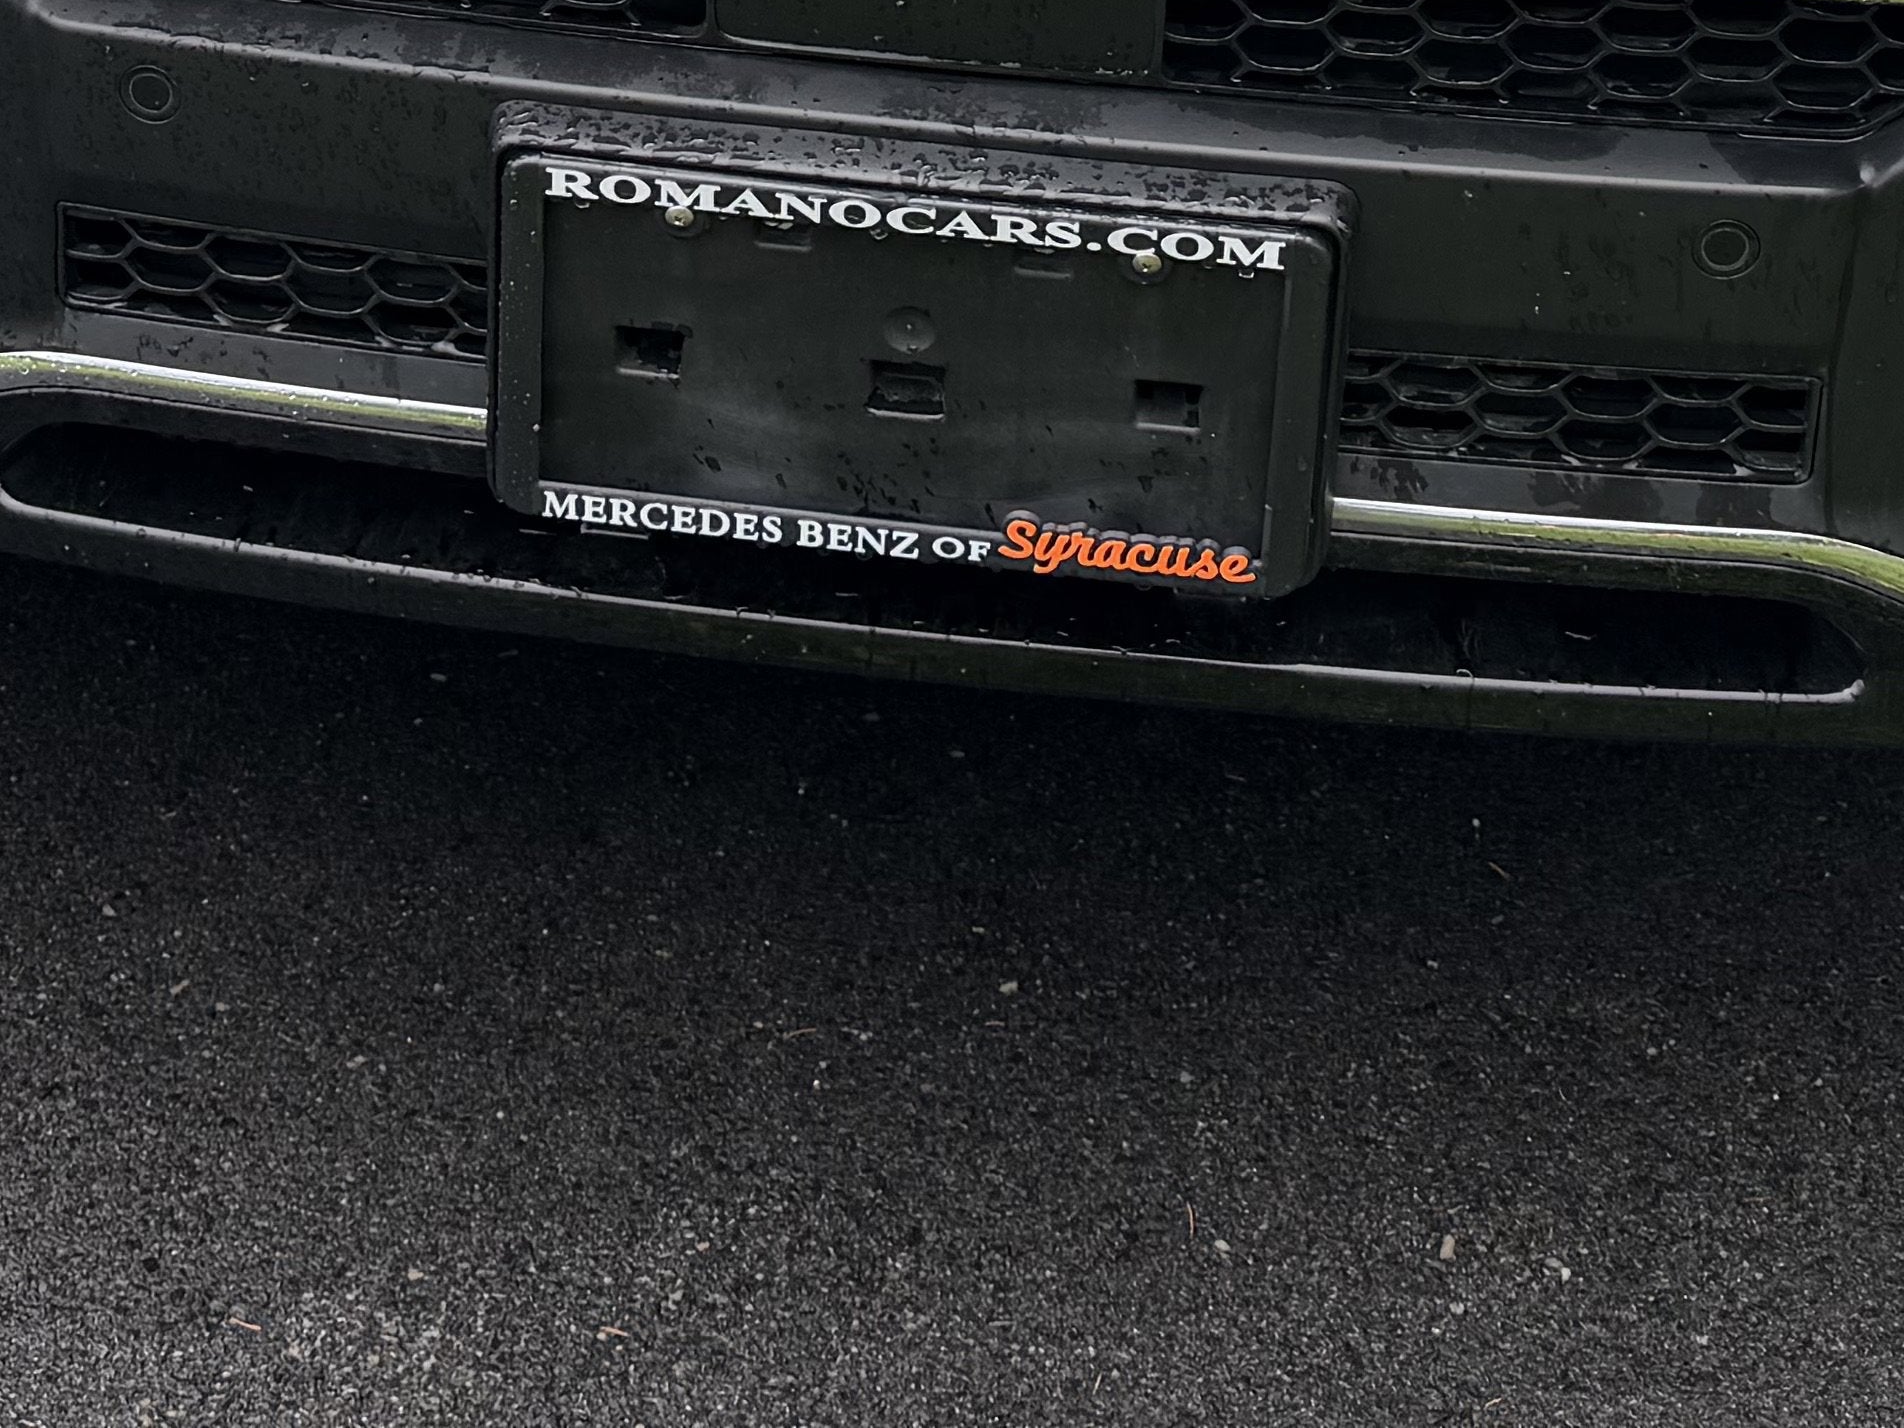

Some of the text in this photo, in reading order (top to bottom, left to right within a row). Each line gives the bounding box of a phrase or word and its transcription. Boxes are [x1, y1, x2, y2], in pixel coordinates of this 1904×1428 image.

[544, 166, 1287, 271] ROMANOCARS.COM
[541, 490, 1257, 584] MERCEDES BENZ OF Syracuse
